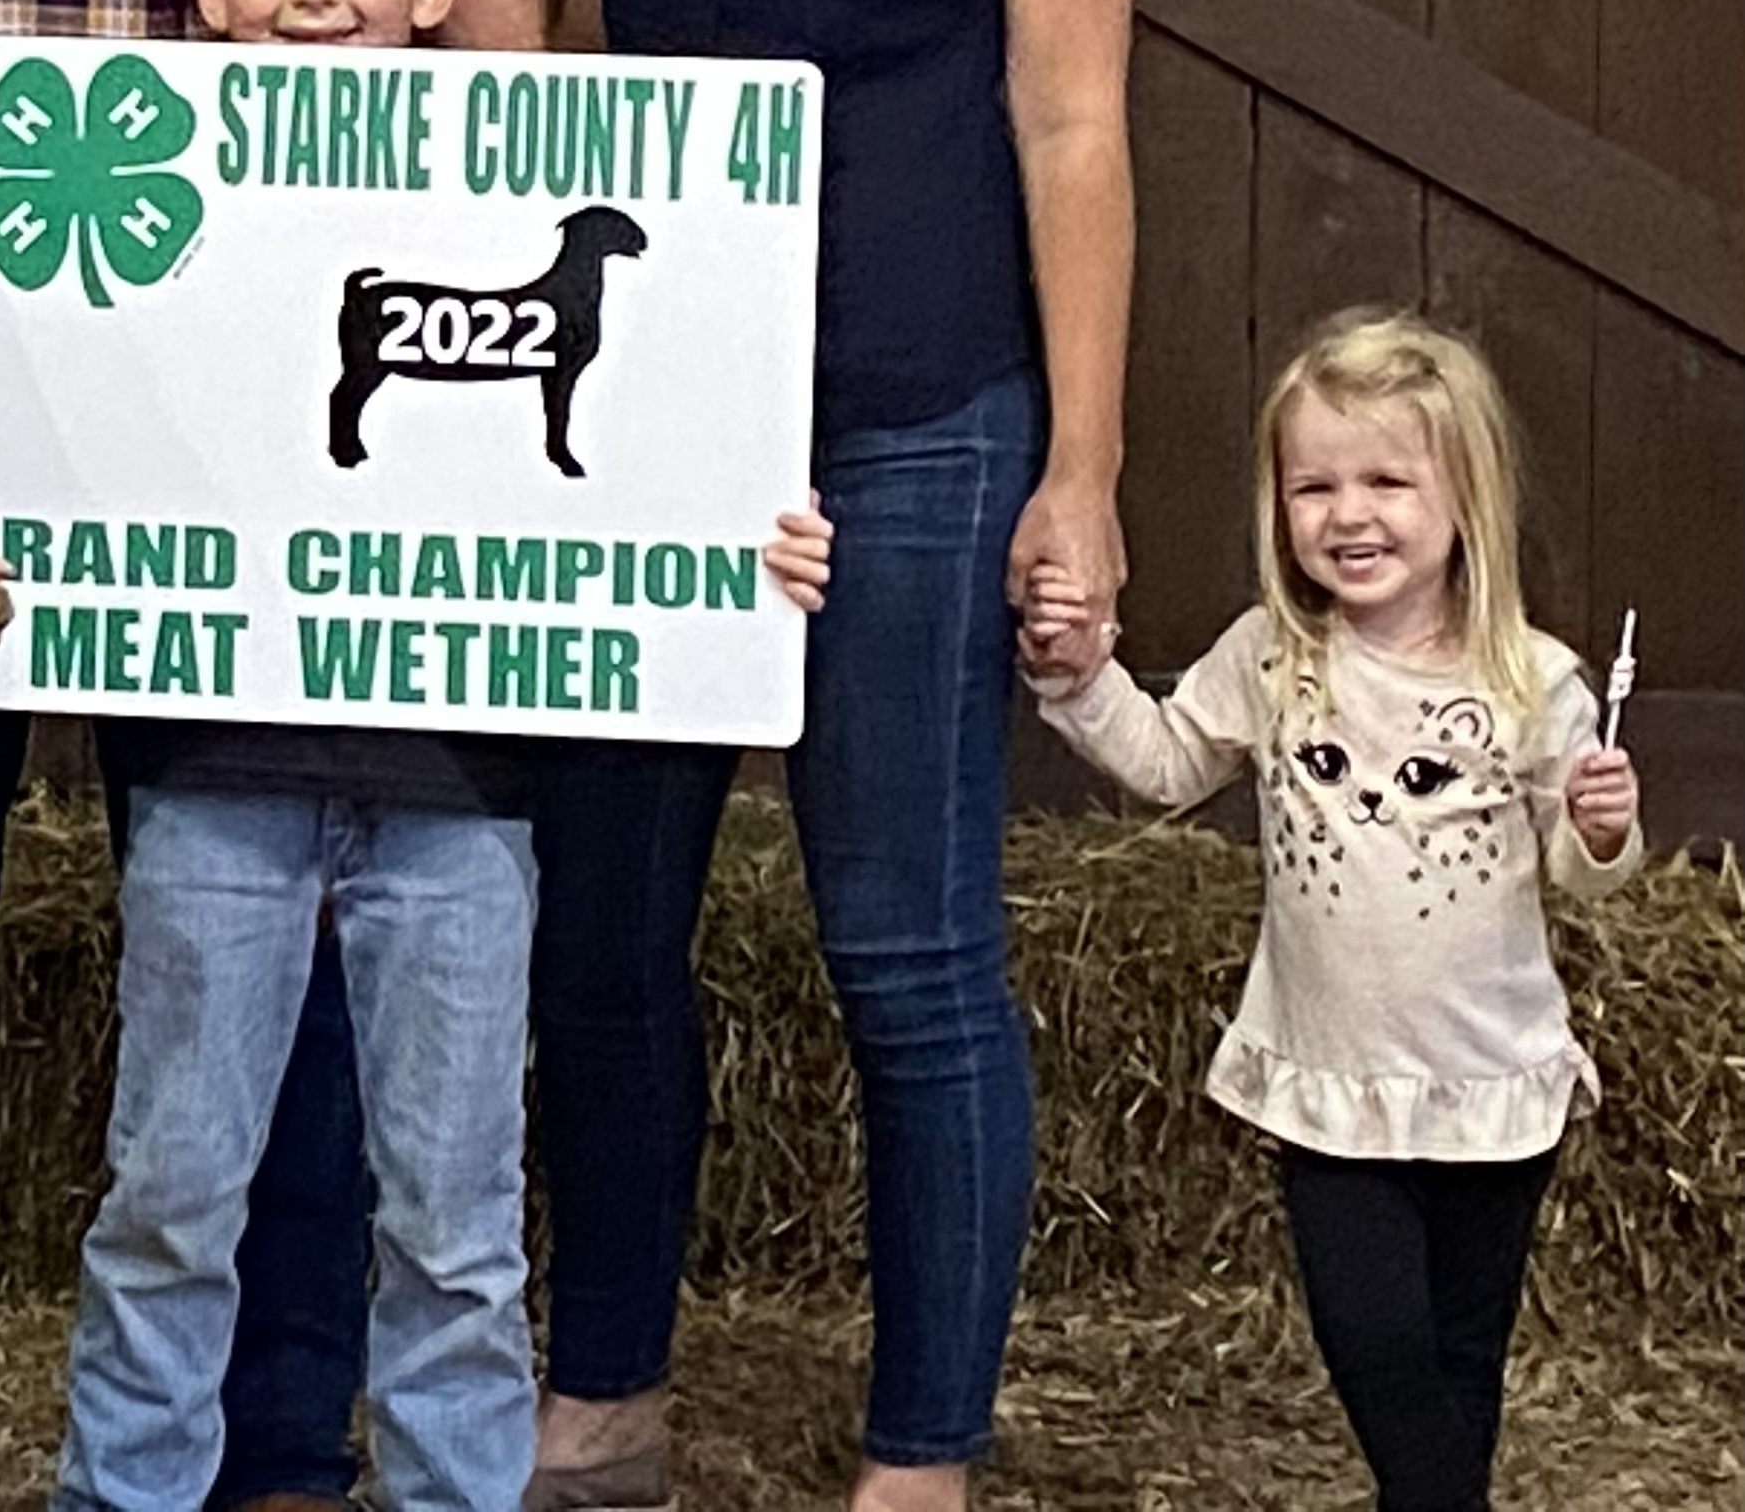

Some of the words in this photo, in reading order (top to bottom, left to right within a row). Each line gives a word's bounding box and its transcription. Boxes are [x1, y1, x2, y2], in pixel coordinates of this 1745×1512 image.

[1, 95, 54, 146] H
[108, 87, 160, 140] H
[217, 63, 433, 190] STARKE
[465, 71, 695, 201] COUNTY
[728, 78, 804, 205] 4H
[120, 196, 172, 250] H
[378, 297, 557, 366] 2022
[288, 529, 757, 610] CHAMPION
[31, 606, 249, 696] MEAT
[298, 616, 640, 713] WETHER
